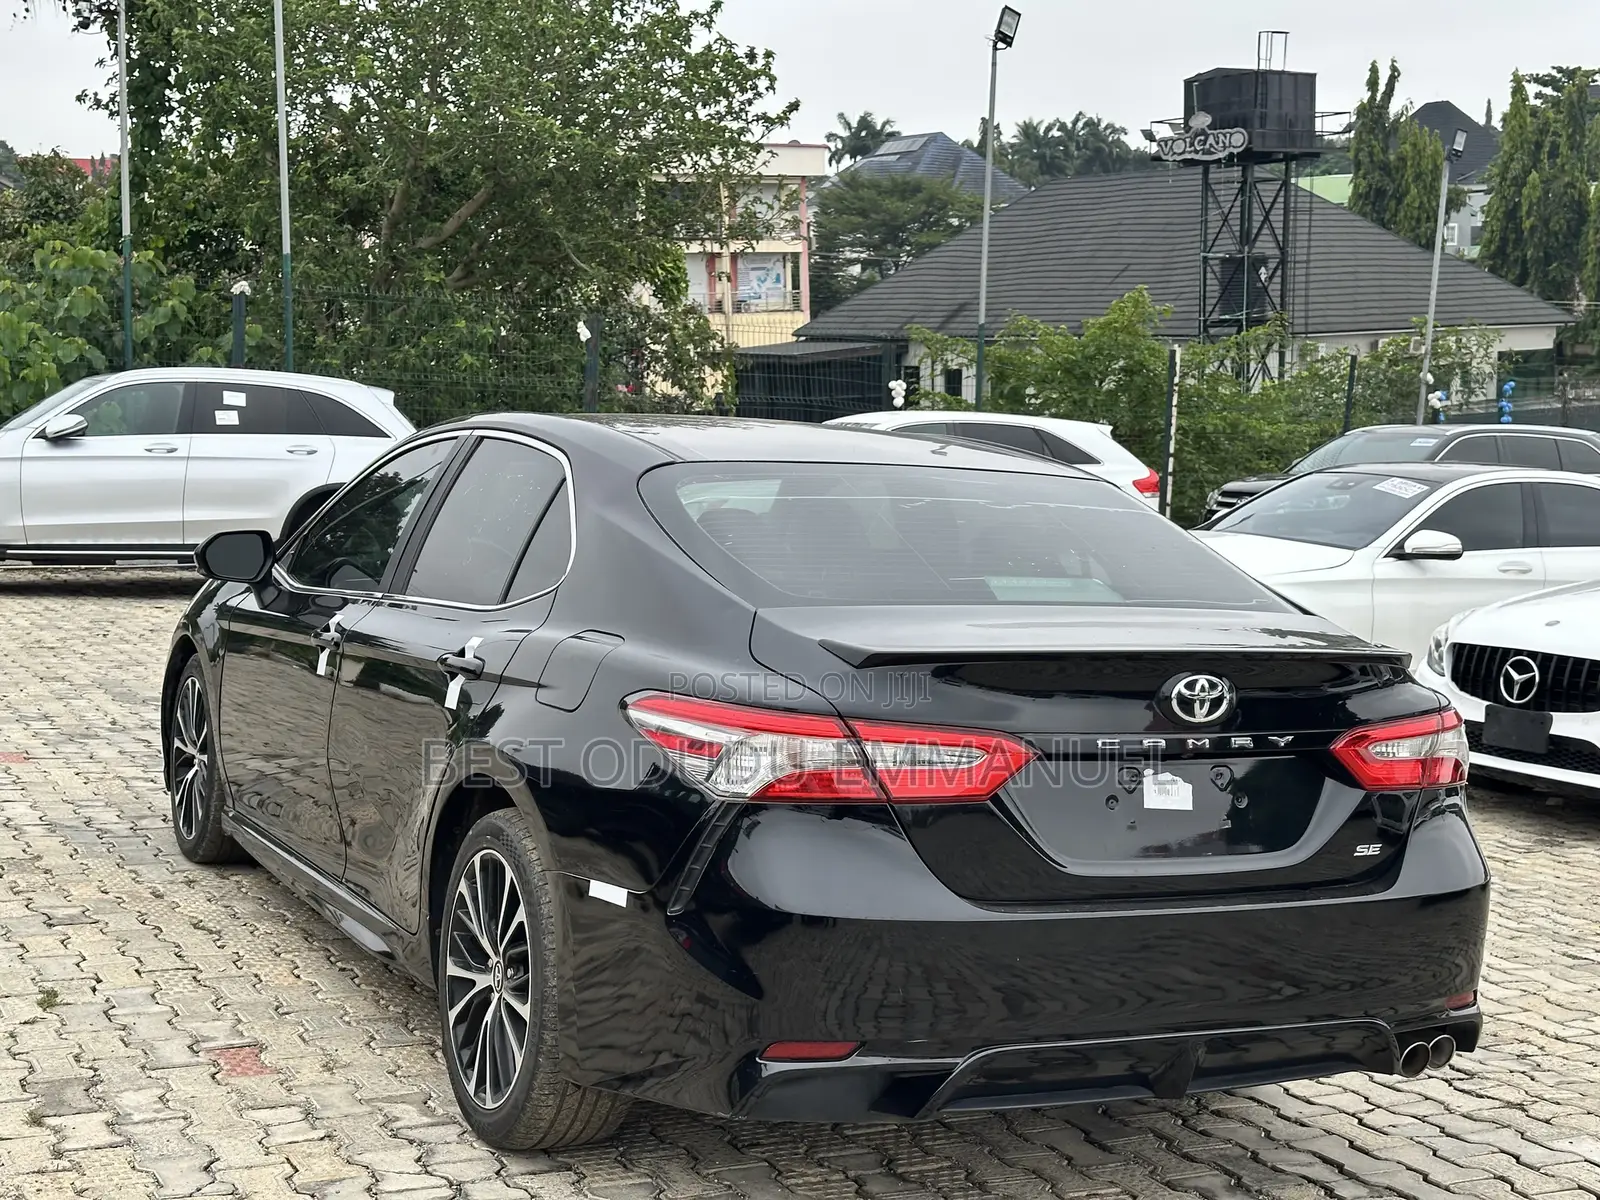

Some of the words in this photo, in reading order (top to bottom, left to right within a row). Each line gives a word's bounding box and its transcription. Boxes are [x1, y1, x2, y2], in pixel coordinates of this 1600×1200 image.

[1159, 131, 1246, 155] VOLCANO
[1096, 735, 1295, 749] CAMRY
[1353, 843, 1383, 857] SE
